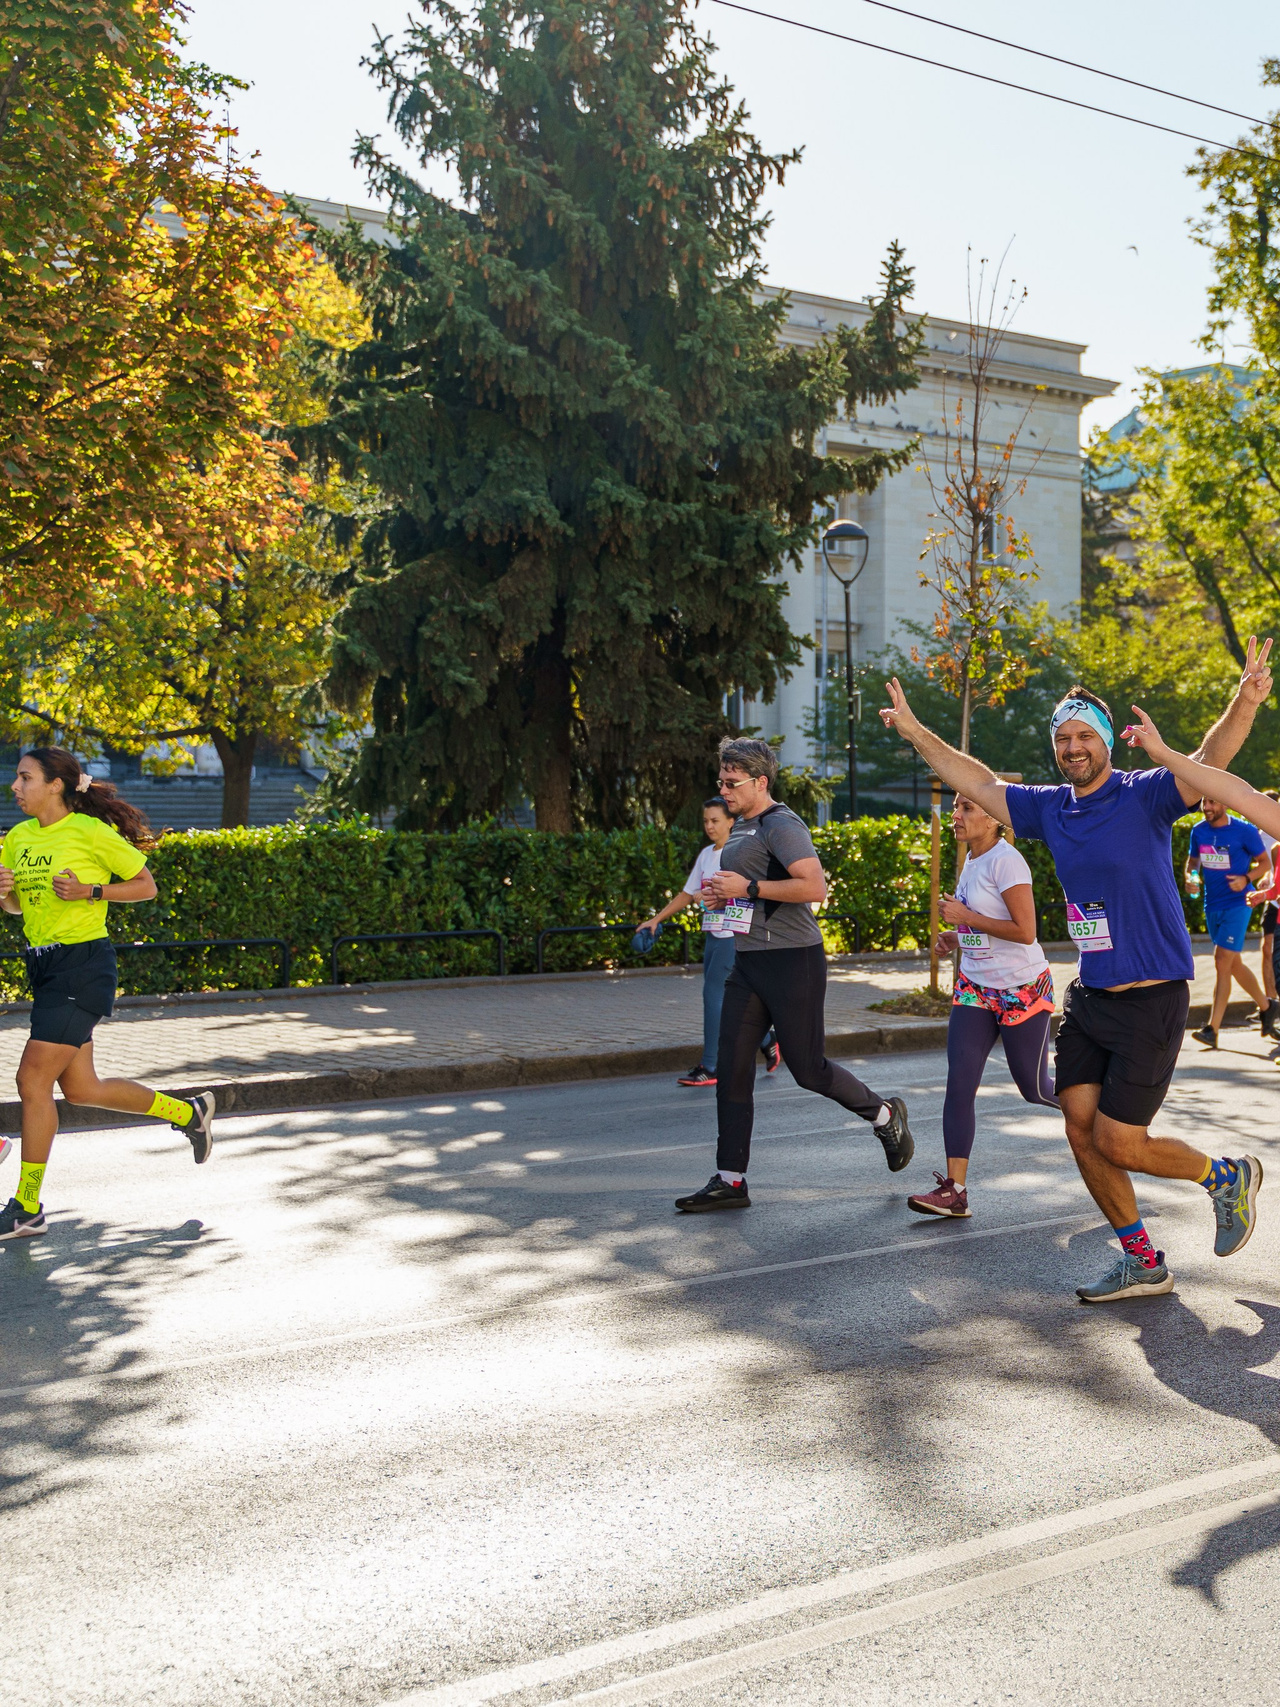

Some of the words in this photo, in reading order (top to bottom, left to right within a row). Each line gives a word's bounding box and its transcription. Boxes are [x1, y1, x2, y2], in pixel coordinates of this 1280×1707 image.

[1071, 921, 1097, 936] 3657
[962, 935, 982, 946] 4666
[24, 1169, 42, 1202] FILA
